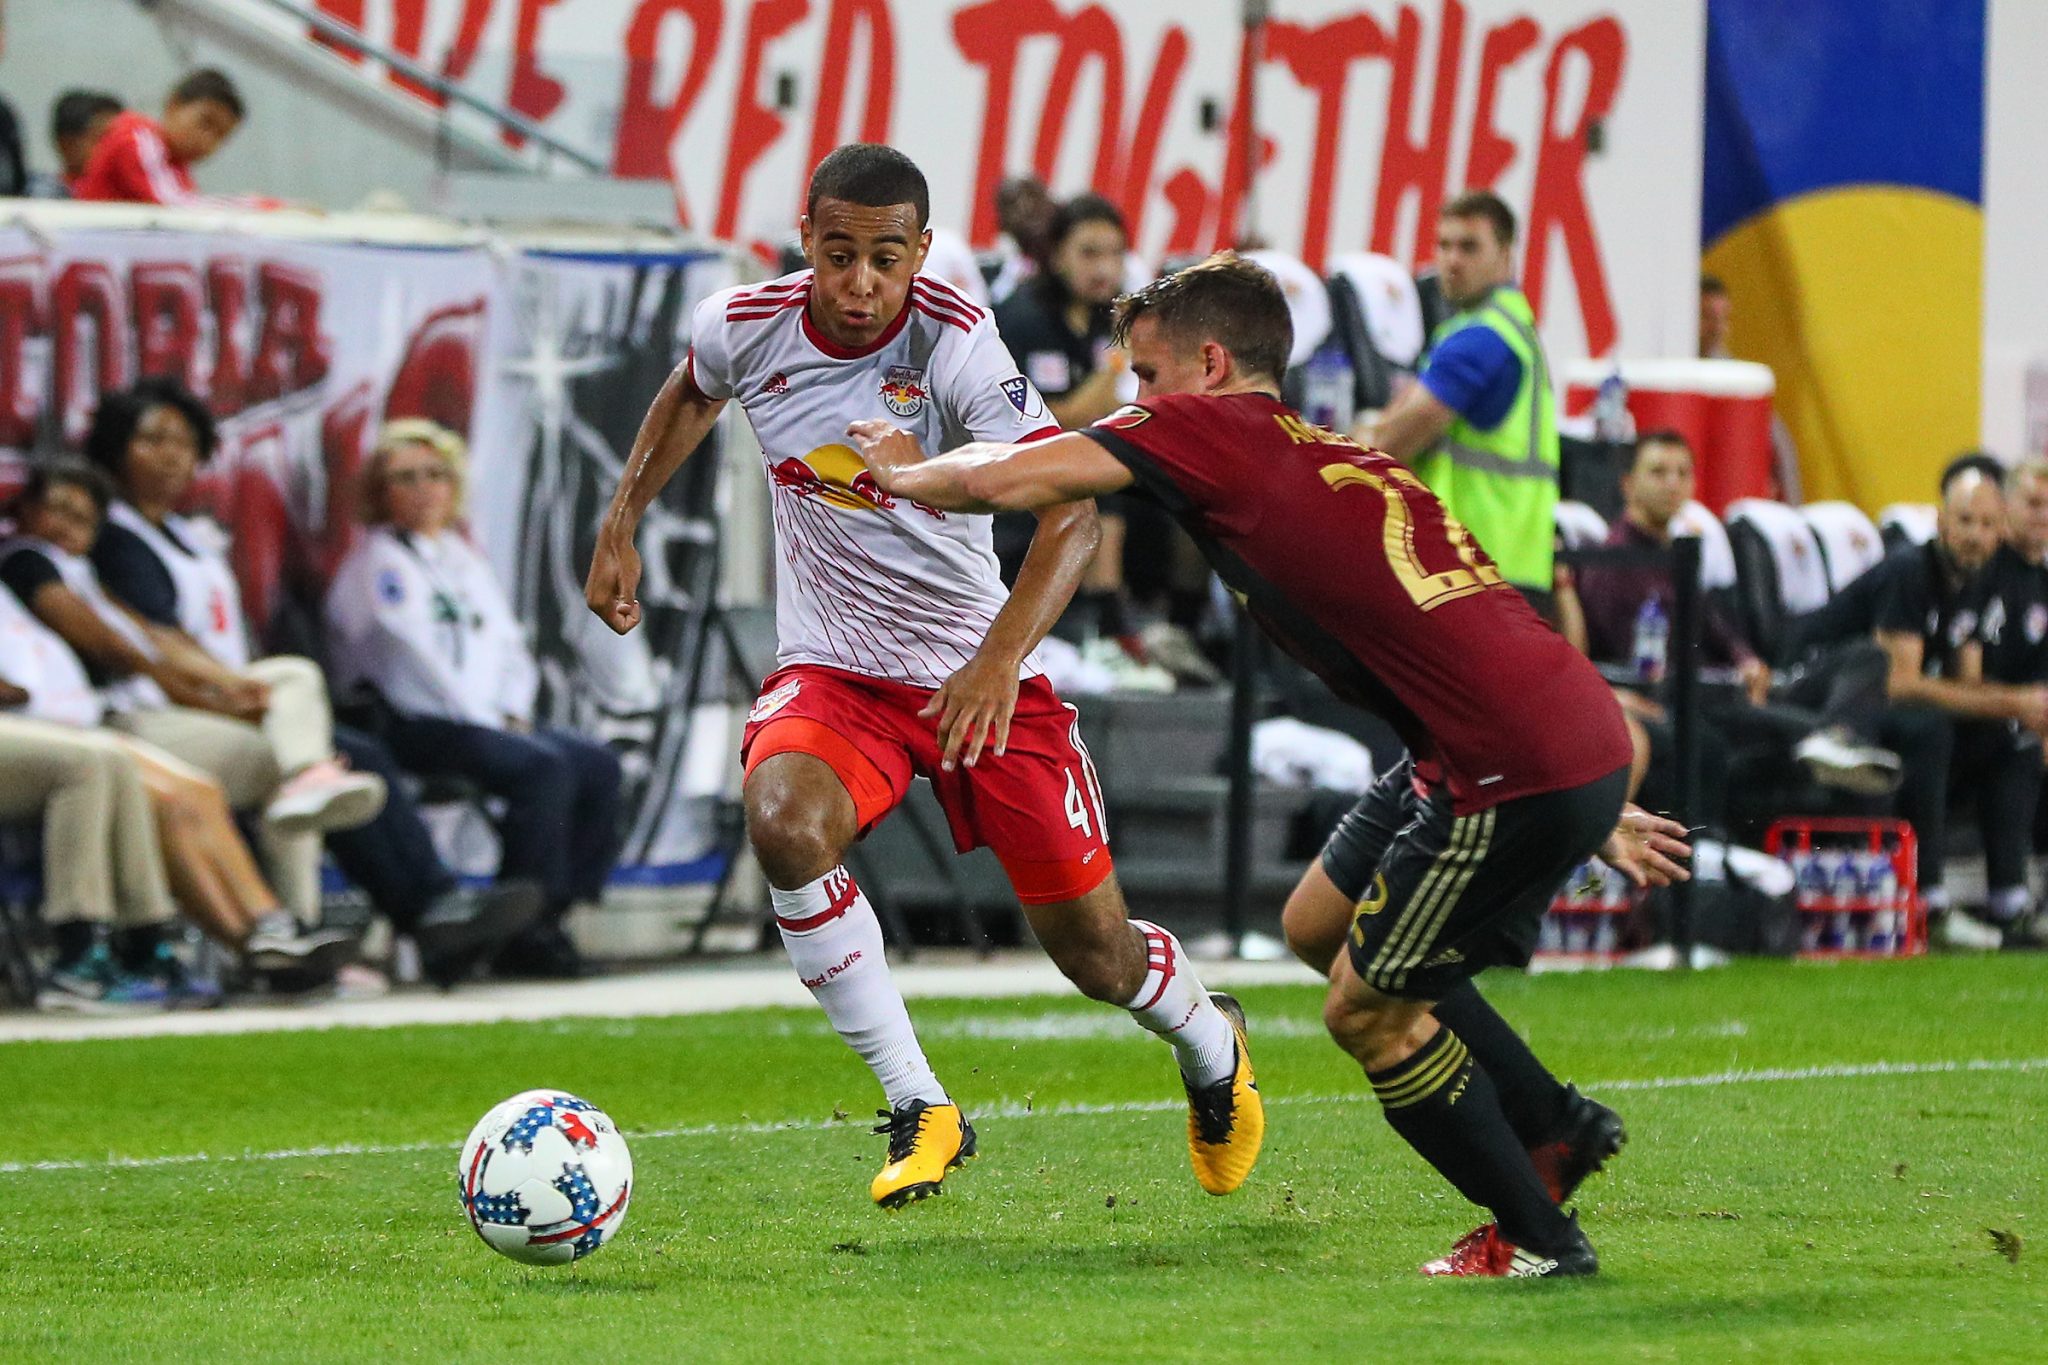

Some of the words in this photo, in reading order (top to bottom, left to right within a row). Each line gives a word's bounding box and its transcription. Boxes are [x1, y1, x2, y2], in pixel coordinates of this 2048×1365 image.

[949, 0, 1628, 362] TOGETHER
[1002, 378, 1025, 393] MLS
[1063, 766, 1092, 838] 4
[826, 949, 863, 979] Bulls
